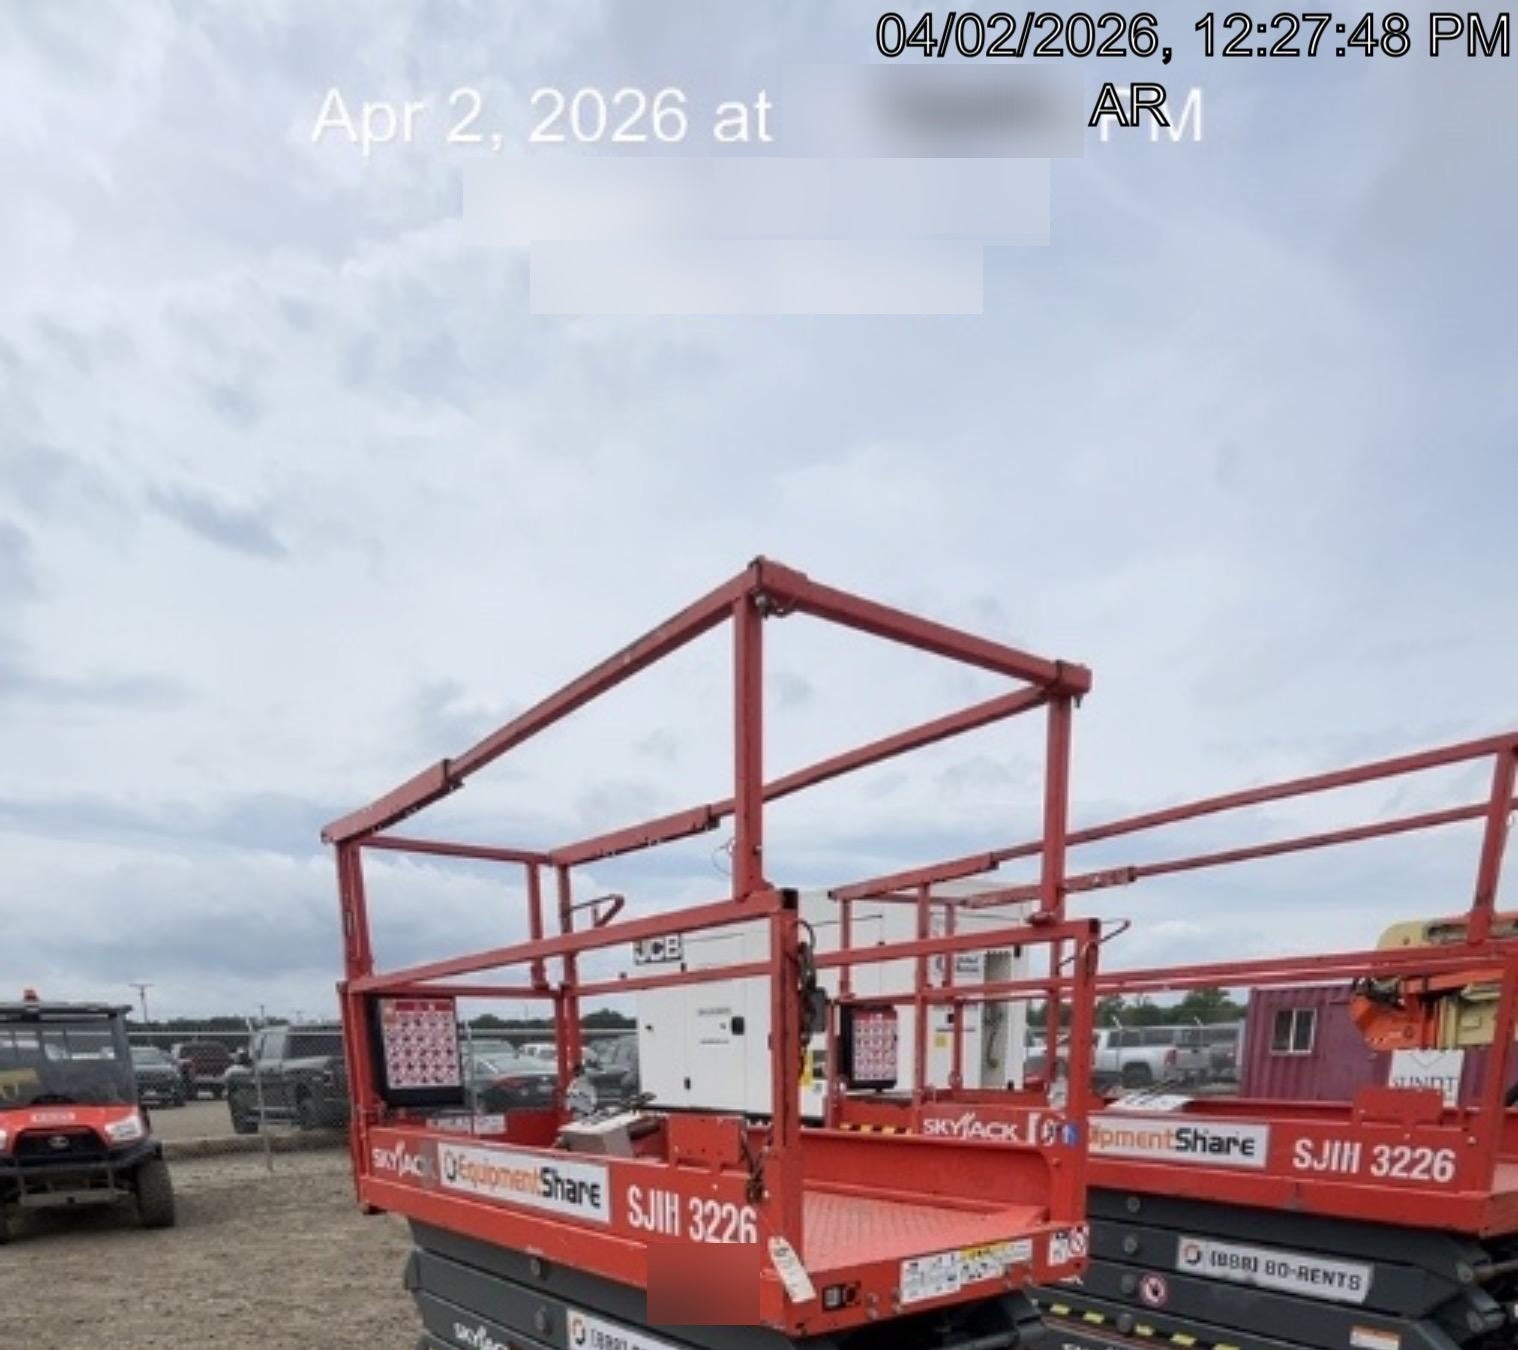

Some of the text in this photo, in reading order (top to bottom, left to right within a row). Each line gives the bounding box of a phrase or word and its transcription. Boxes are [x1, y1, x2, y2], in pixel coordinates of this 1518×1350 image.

[633, 934, 683, 964] JCB
[923, 1113, 1018, 1140] SKYJACK
[371, 1141, 438, 1179] SKYJAC
[1369, 1143, 1456, 1183] 3226
[457, 1163, 602, 1210] EquipmentShare
[687, 1197, 758, 1244] 3226
